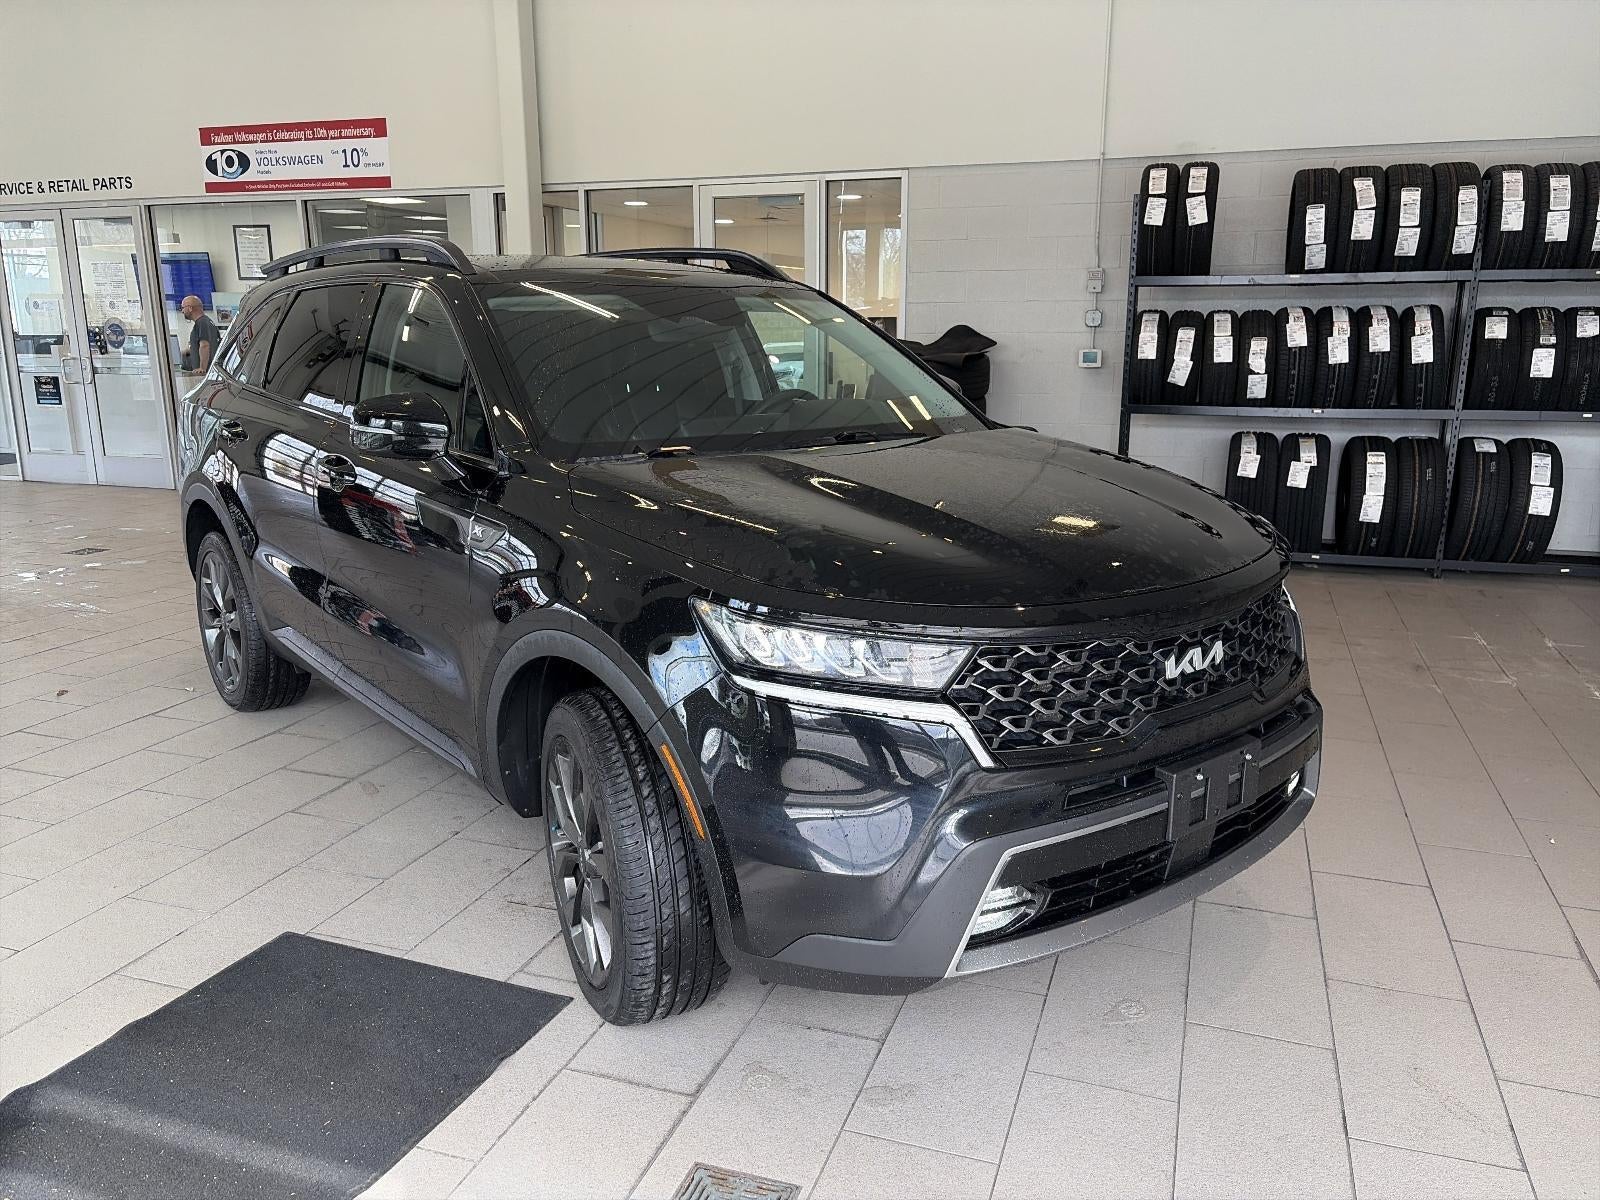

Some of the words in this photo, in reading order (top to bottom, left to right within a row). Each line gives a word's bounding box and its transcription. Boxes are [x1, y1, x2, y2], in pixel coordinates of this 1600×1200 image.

[210, 133, 234, 143] Faulkner
[234, 131, 267, 143] Volkswagen
[267, 130, 273, 140] is
[273, 128, 305, 141] Celebrating
[313, 127, 328, 138] 10th
[328, 128, 340, 140] year
[256, 155, 324, 167] VOLKSWAGEN
[0, 182, 34, 195] RVICE
[36, 181, 46, 194] &
[48, 178, 90, 193] RETAIL
[92, 176, 133, 191] PARTS
